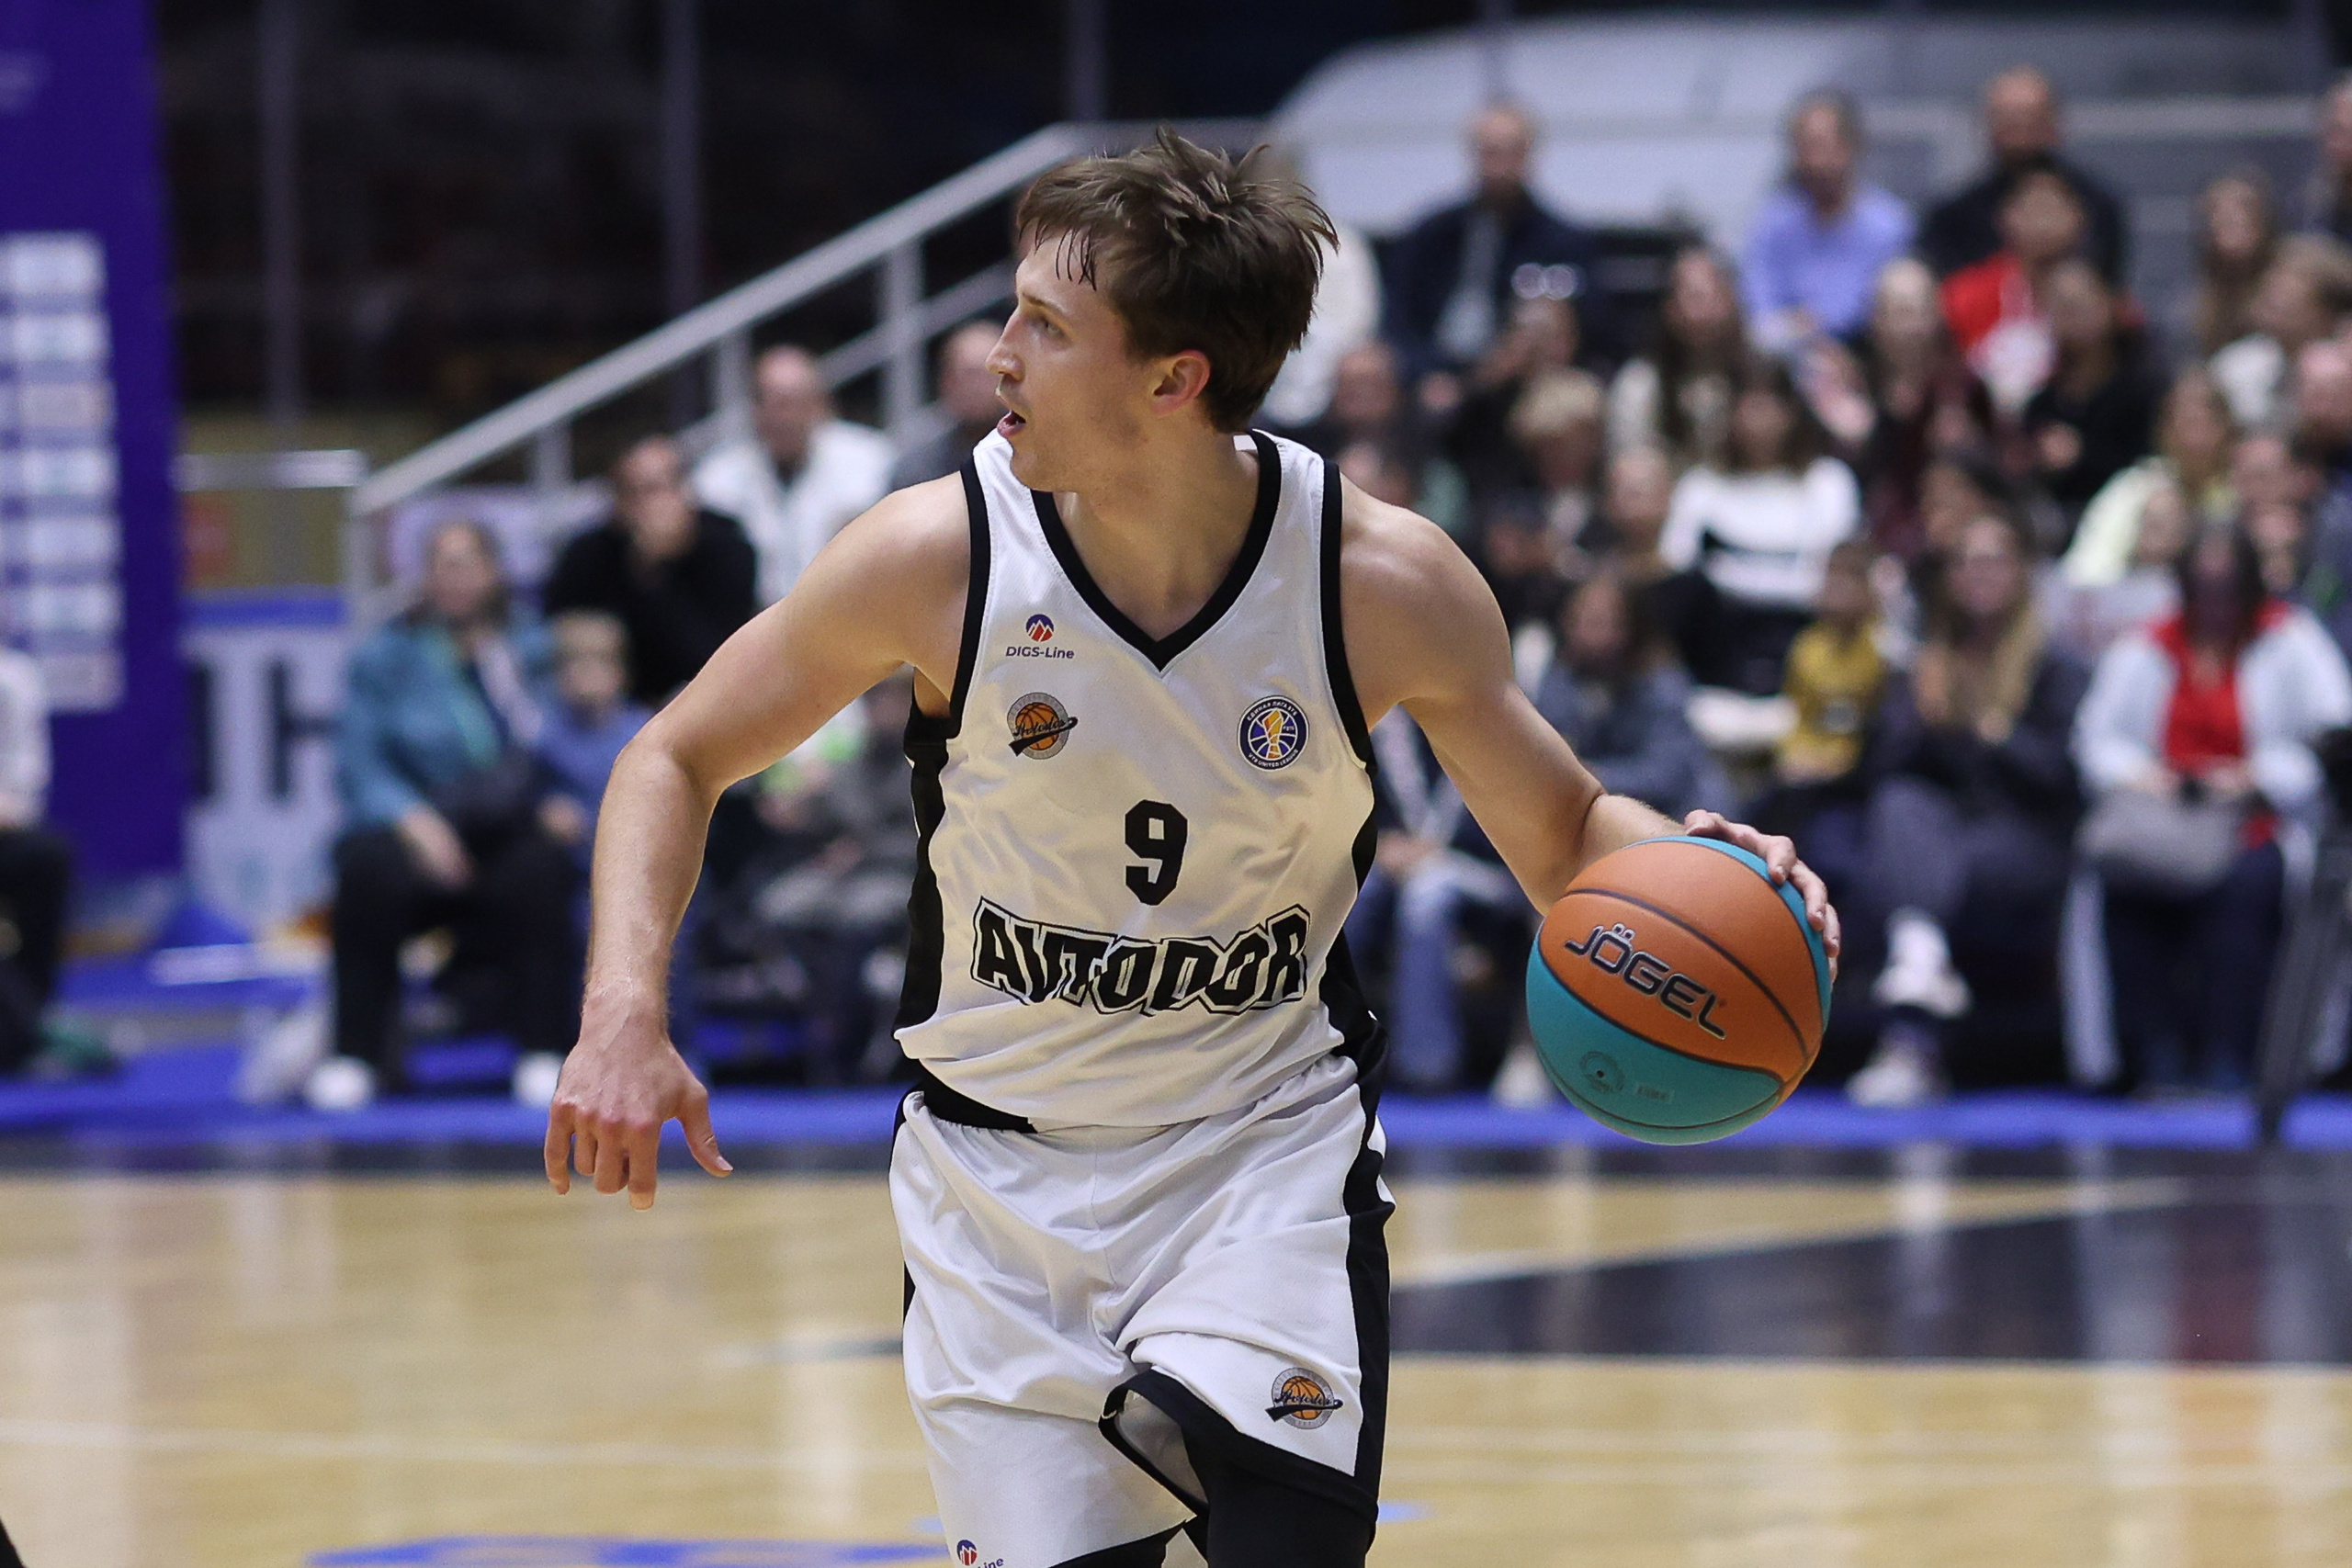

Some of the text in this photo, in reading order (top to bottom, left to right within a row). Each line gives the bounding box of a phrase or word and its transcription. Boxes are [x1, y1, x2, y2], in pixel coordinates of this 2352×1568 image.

[1005, 646, 1075, 660] DIGS-Line
[1125, 799, 1188, 906] 9
[970, 896, 1311, 1017] AVTODOR
[1564, 922, 1727, 1040] JÖGEL
